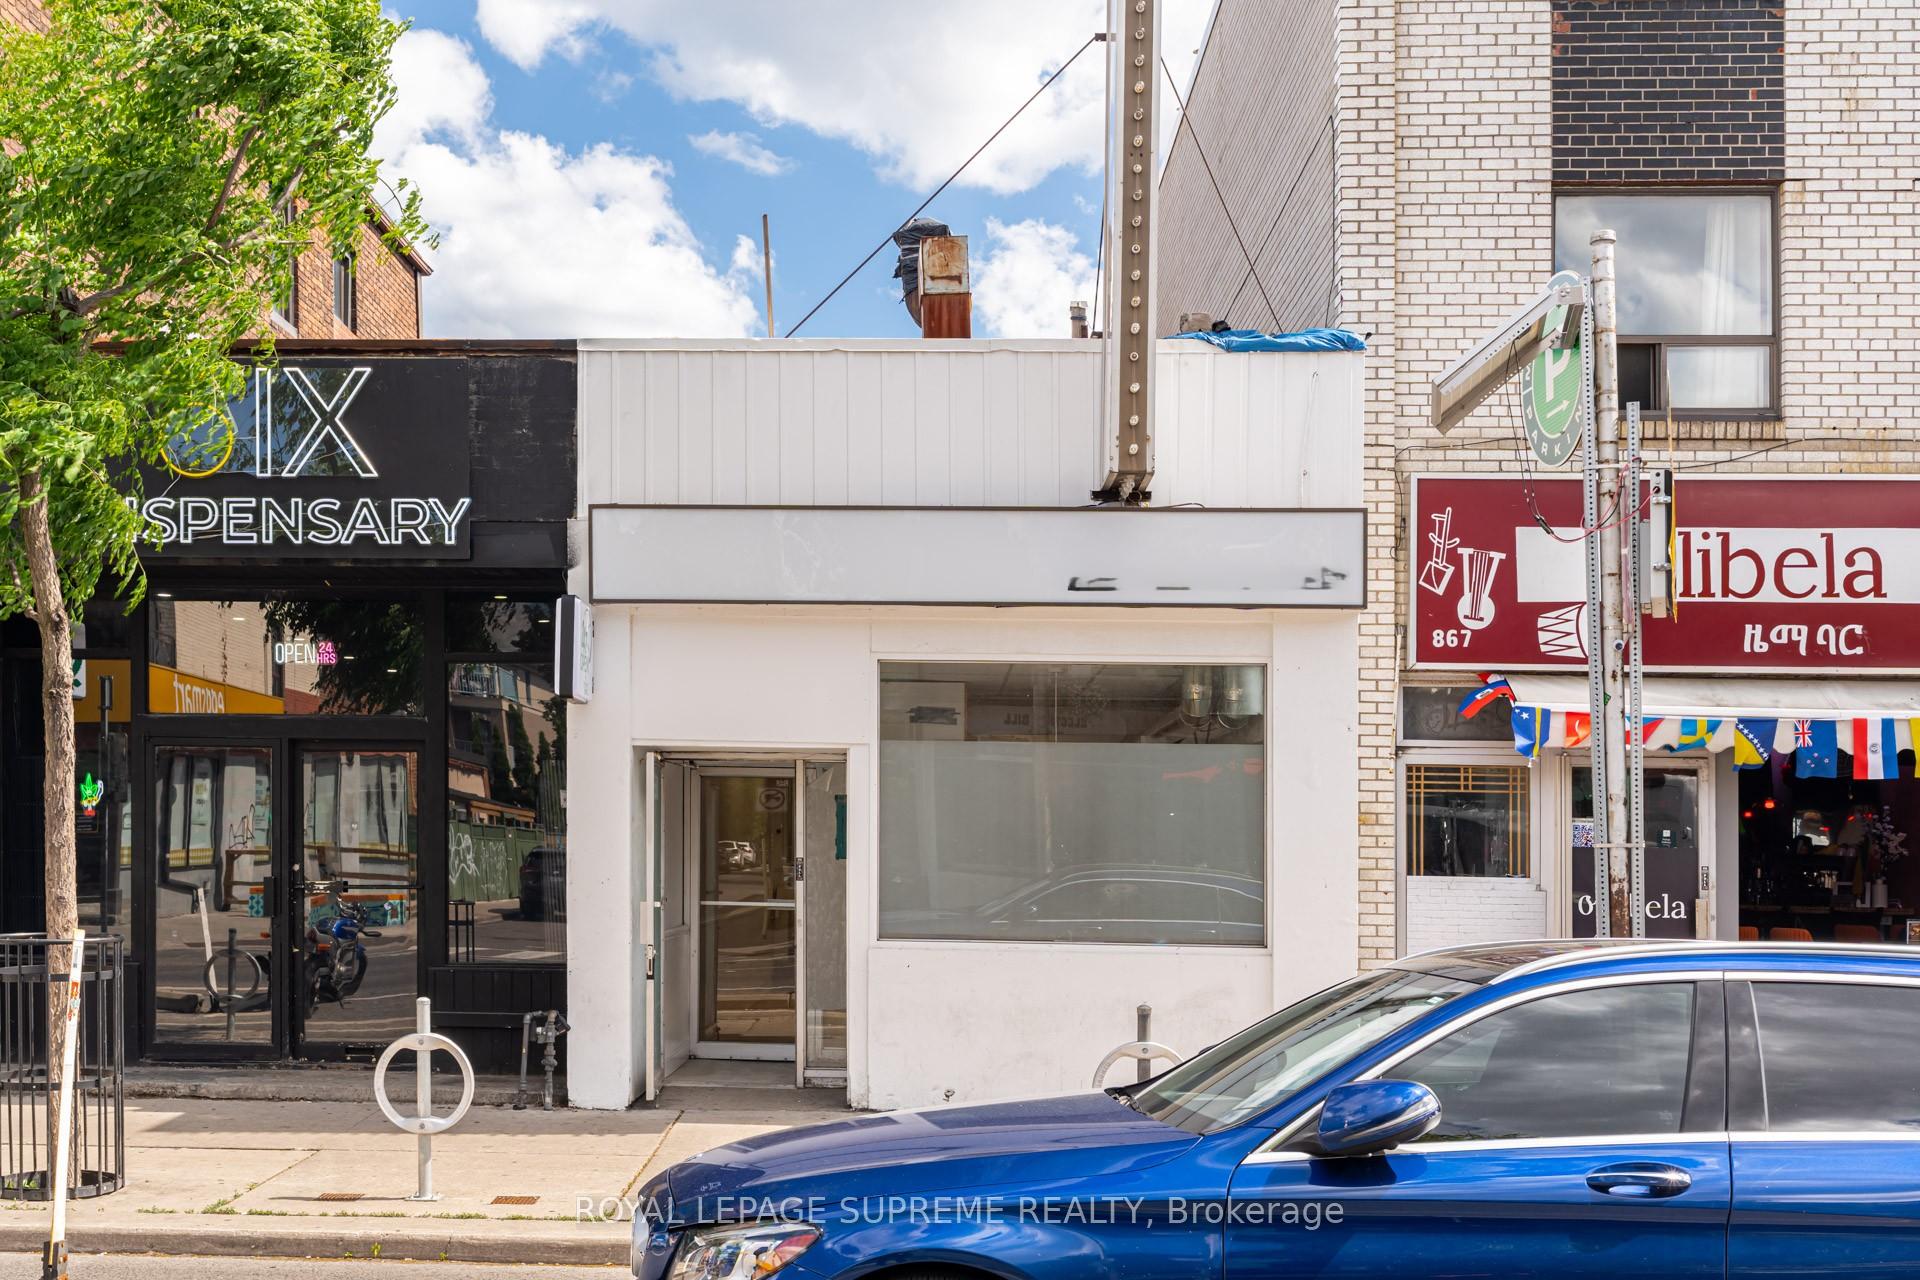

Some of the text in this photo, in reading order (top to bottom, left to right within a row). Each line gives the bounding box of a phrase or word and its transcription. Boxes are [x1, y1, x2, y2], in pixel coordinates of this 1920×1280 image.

[1526, 404, 1582, 457] PARKIN
[111, 497, 472, 545] ISPENSARY
[1432, 629, 1472, 648] 867
[275, 642, 334, 664] OPEN 24
[316, 653, 336, 664] HRS
